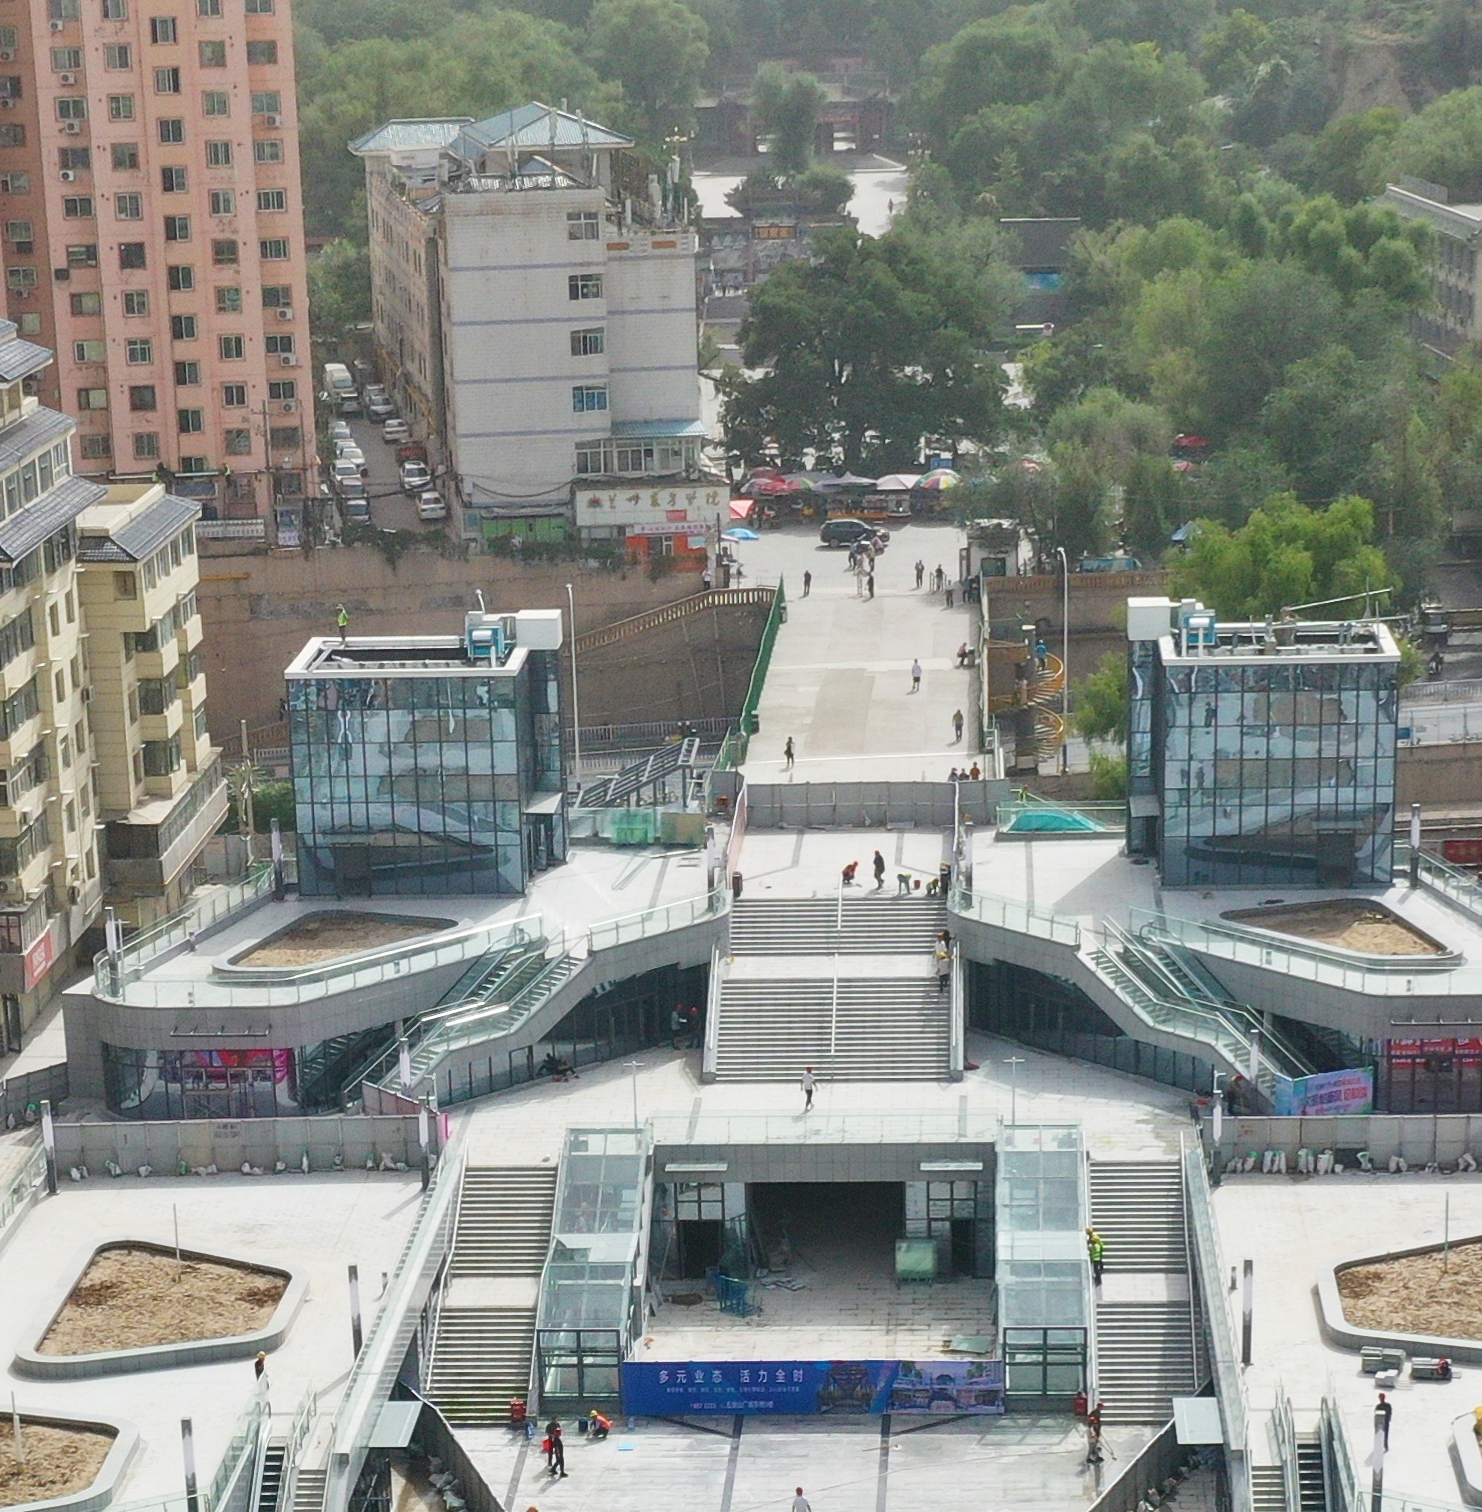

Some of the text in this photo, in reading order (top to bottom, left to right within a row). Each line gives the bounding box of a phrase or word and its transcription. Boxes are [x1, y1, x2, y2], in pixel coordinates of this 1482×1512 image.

[658, 1368, 805, 1384] 多元业态 活力全时
